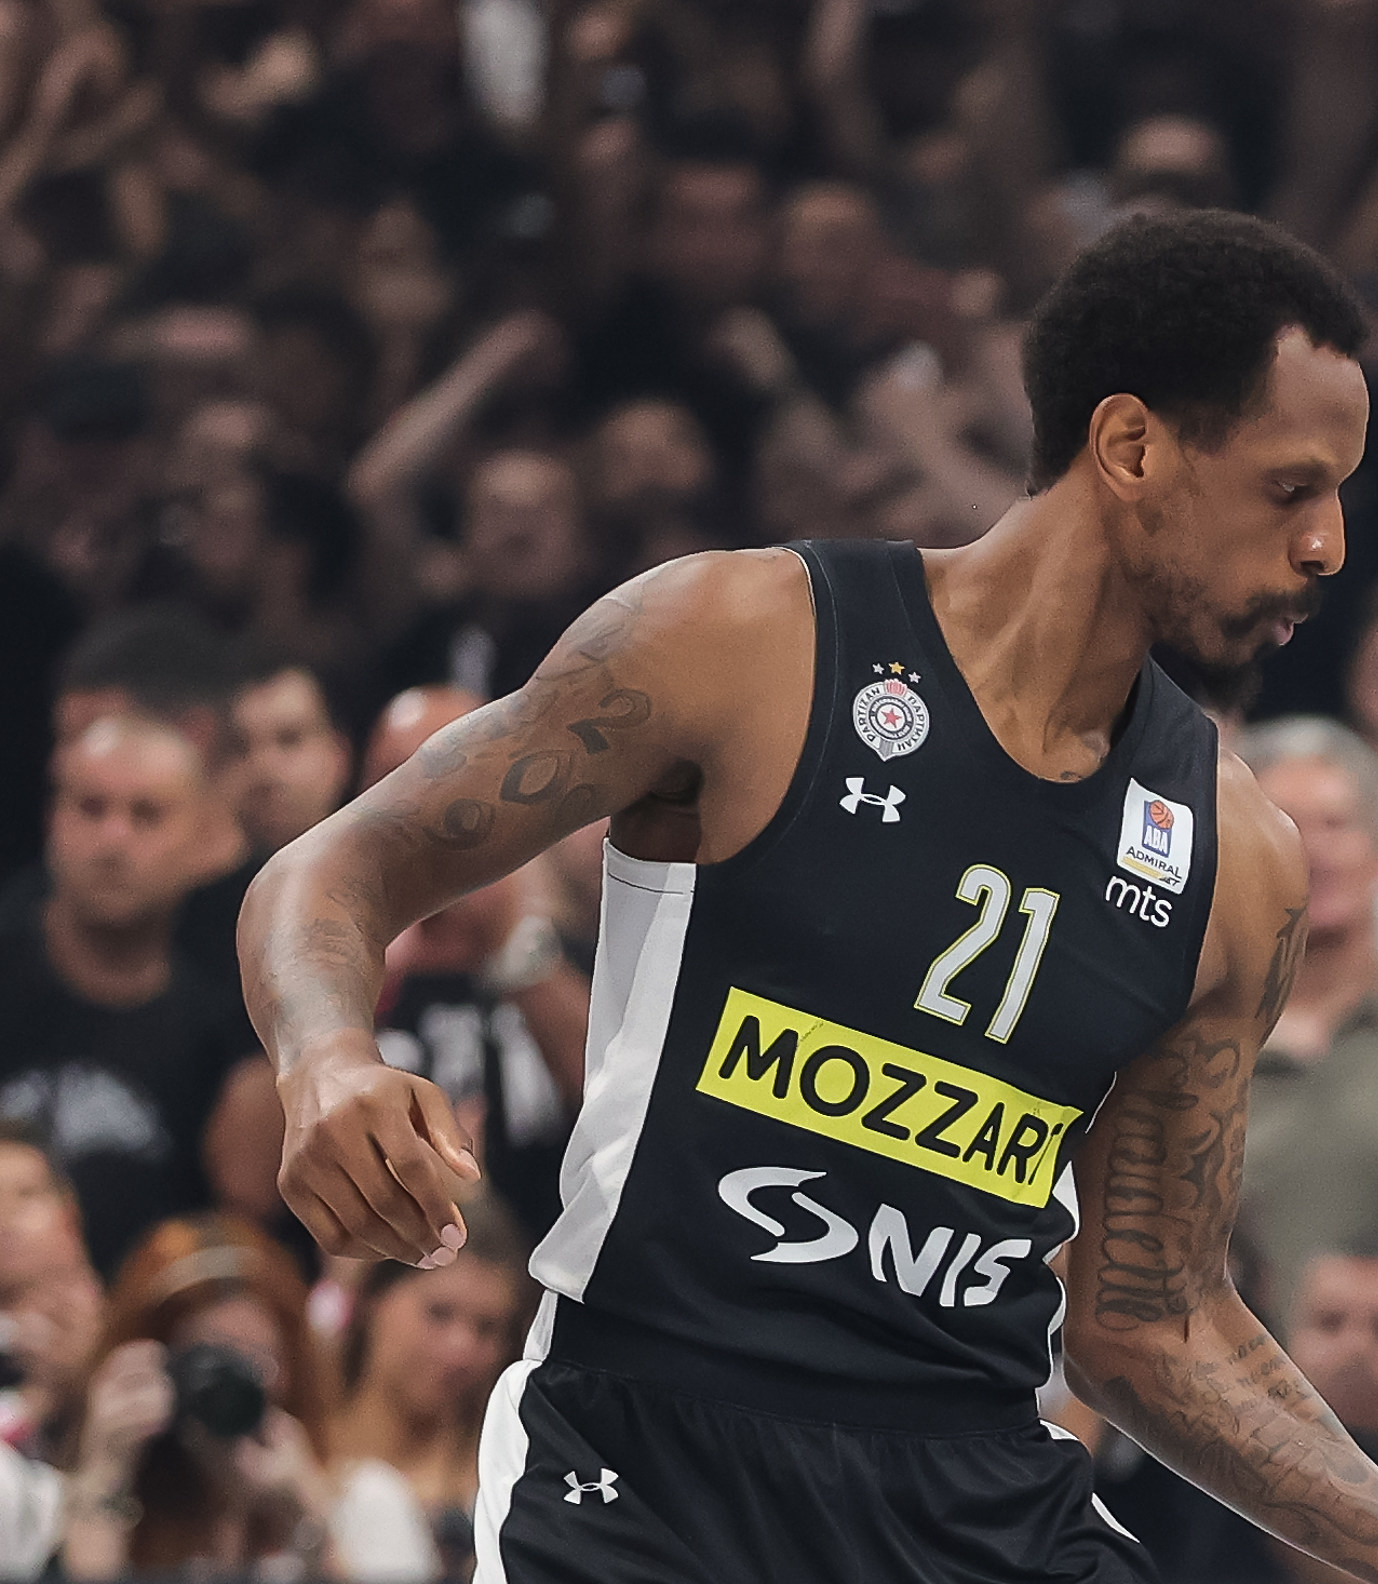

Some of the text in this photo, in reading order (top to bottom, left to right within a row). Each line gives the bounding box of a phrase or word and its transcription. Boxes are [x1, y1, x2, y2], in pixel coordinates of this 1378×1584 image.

[1105, 875, 1173, 928] mts
[1126, 846, 1183, 880] ADMIRAL
[913, 863, 1061, 1045] 21
[867, 1203, 1032, 1308] NIS
